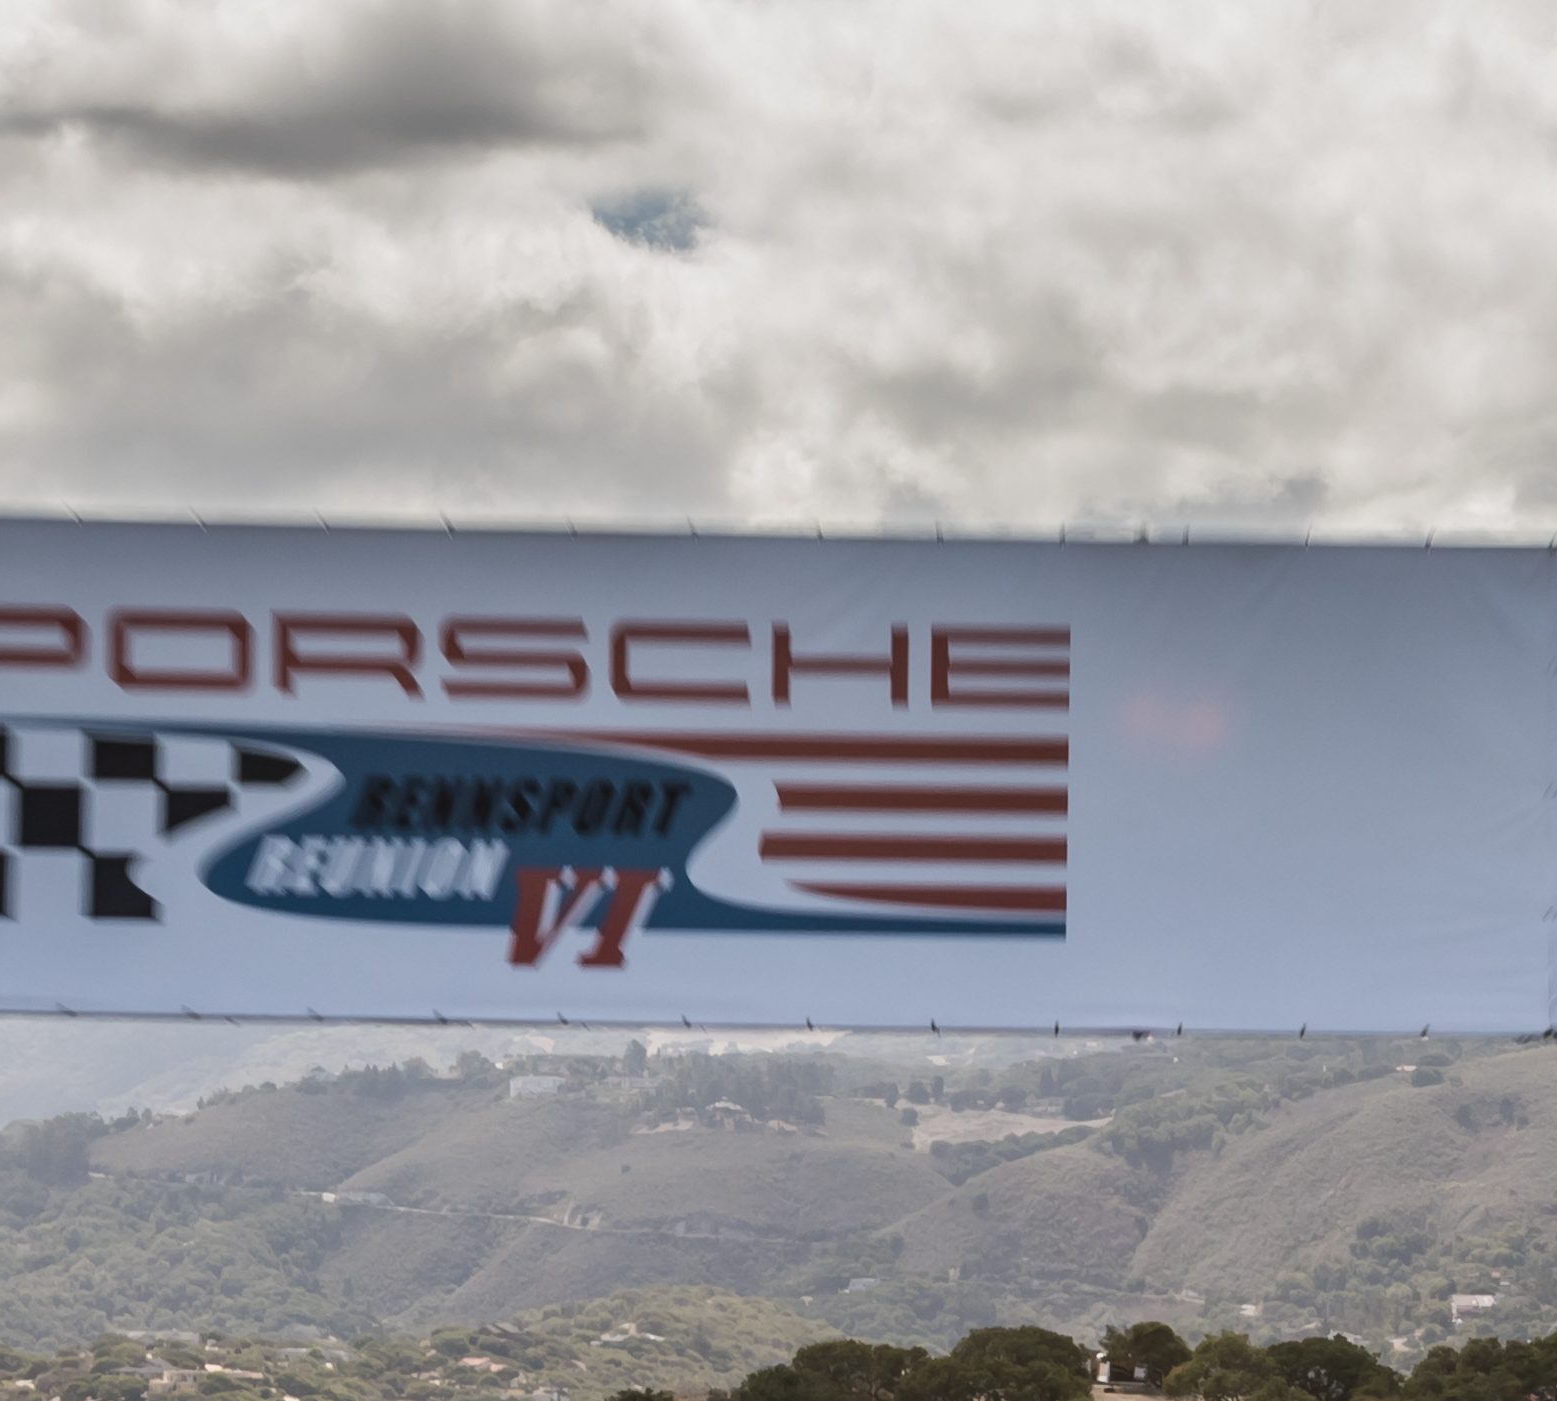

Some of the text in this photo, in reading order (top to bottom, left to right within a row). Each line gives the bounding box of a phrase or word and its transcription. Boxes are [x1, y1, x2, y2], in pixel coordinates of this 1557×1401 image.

[349, 772, 690, 837] RENNSPORT
[245, 833, 510, 900] REUNION
[507, 866, 671, 969] VI
